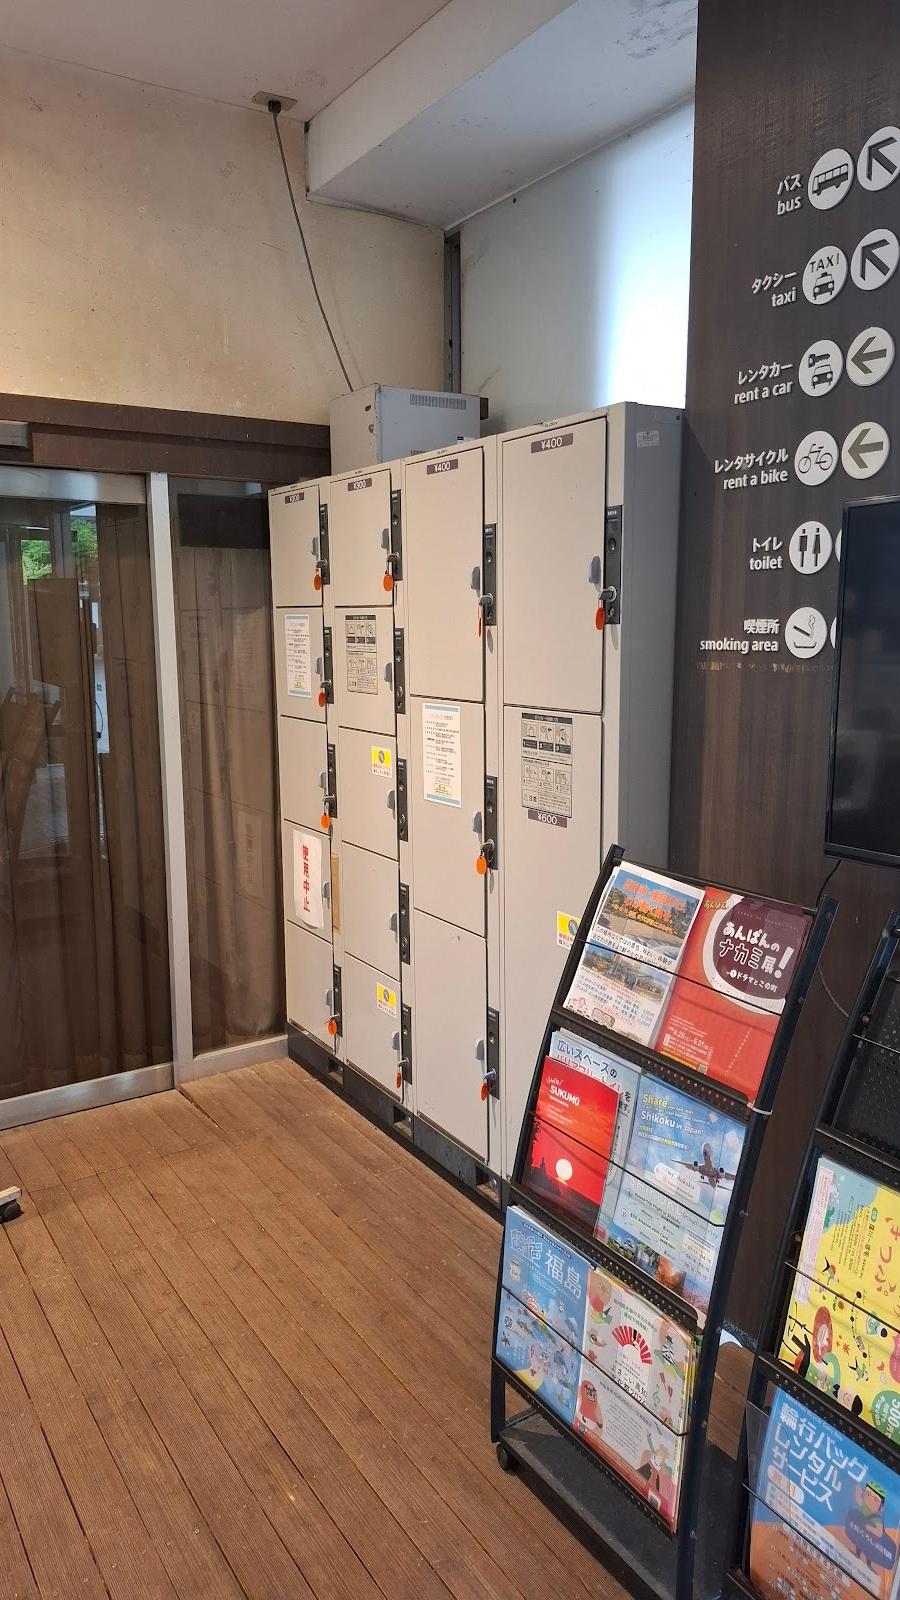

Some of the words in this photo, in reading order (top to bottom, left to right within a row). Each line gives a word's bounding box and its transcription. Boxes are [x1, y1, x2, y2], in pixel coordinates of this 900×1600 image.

[777, 173, 802, 196] バス
[777, 196, 802, 215] bus
[810, 253, 840, 273] TAXI
[752, 270, 797, 294] タクシー
[772, 287, 797, 307] taxi
[738, 362, 793, 385] レンタカー
[734, 387, 759, 404] rent
[762, 386, 770, 398] a
[772, 381, 793, 396] car
[541, 436, 562, 450] ¥400
[434, 461, 451, 473] ¥400
[714, 448, 789, 474] レンタサイクル
[723, 474, 748, 489] rent
[750, 475, 758, 486] a
[760, 469, 788, 484] bike
[752, 536, 783, 553] トイレ
[750, 555, 783, 571] toilet
[744, 619, 780, 635] 喫煙所
[700, 637, 749, 654] smoking
[752, 639, 778, 652] area
[537, 811, 557, 825] ¥600
[302, 844, 311, 913] 使用中止
[723, 921, 780, 952] あんぱんの
[557, 1040, 618, 1078] 広いスペースの
[550, 1085, 580, 1106] SUKUMO
[643, 1093, 668, 1108] Share
[641, 1110, 675, 1128] Shikoku
[545, 1249, 581, 1299] 福島
[780, 1401, 869, 1483] 輪行バッグ
[774, 1423, 843, 1493] レンタル
[772, 1445, 833, 1513] サービス
